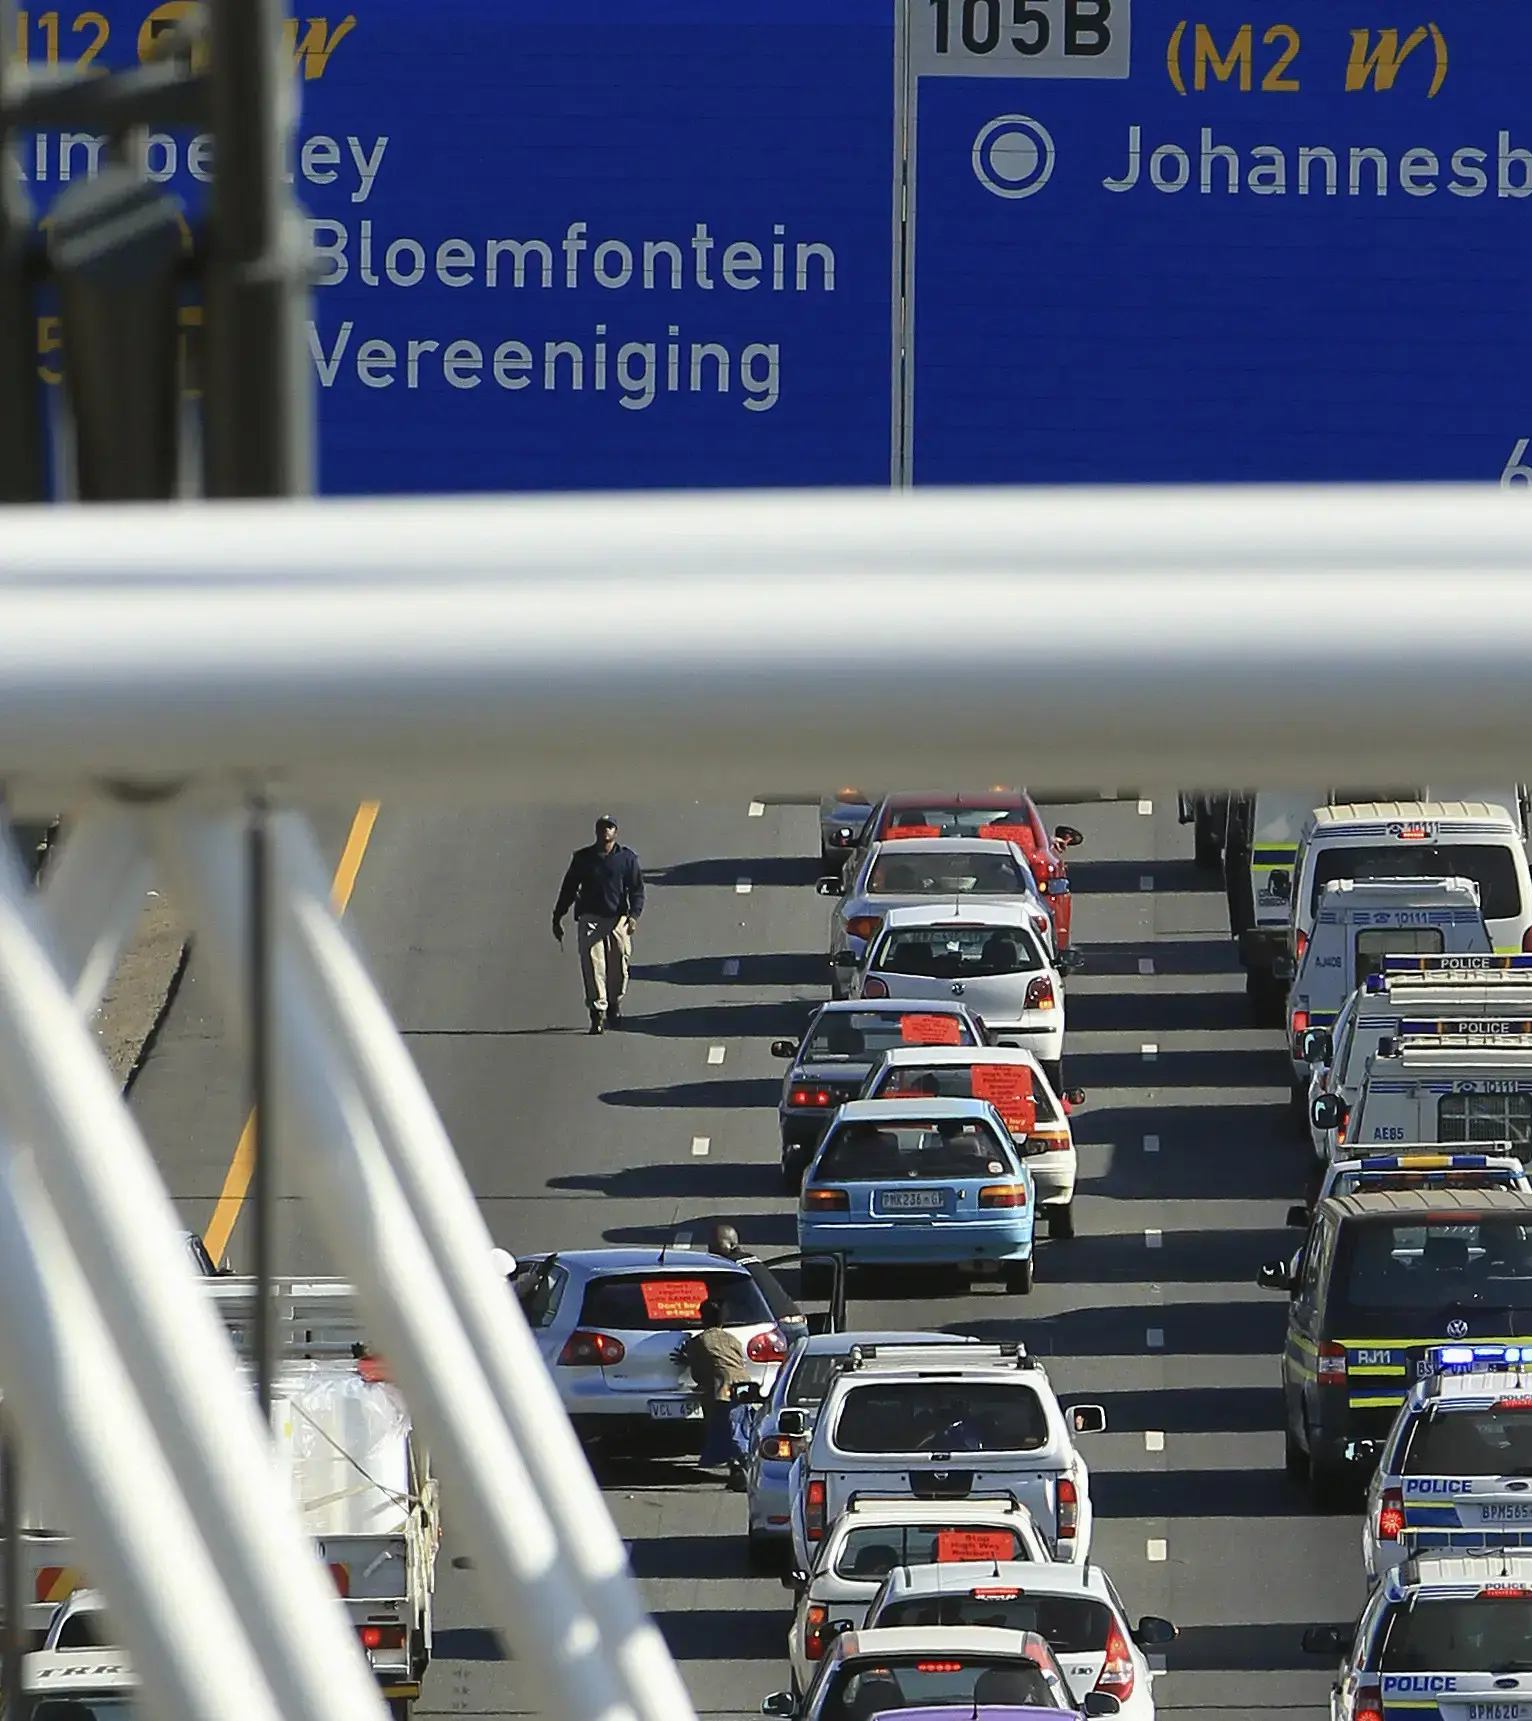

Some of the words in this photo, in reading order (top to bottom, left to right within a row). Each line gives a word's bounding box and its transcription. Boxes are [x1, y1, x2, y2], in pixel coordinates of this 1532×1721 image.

[1167, 20, 1300, 96] (M2
[1345, 23, 1448, 97] W)
[310, 218, 836, 291] Bloemfontein
[308, 320, 780, 411] Vereeniging
[1394, 911, 1429, 924] 10111
[1440, 957, 1490, 969] POLICE
[1458, 1022, 1510, 1034] POLICE
[1373, 1127, 1404, 1140] AE85
[1358, 1350, 1391, 1364] RJ11
[1406, 1479, 1472, 1494] POLICE
[1484, 1582, 1526, 1590] POLICE
[1383, 1676, 1457, 1691] POLICE
